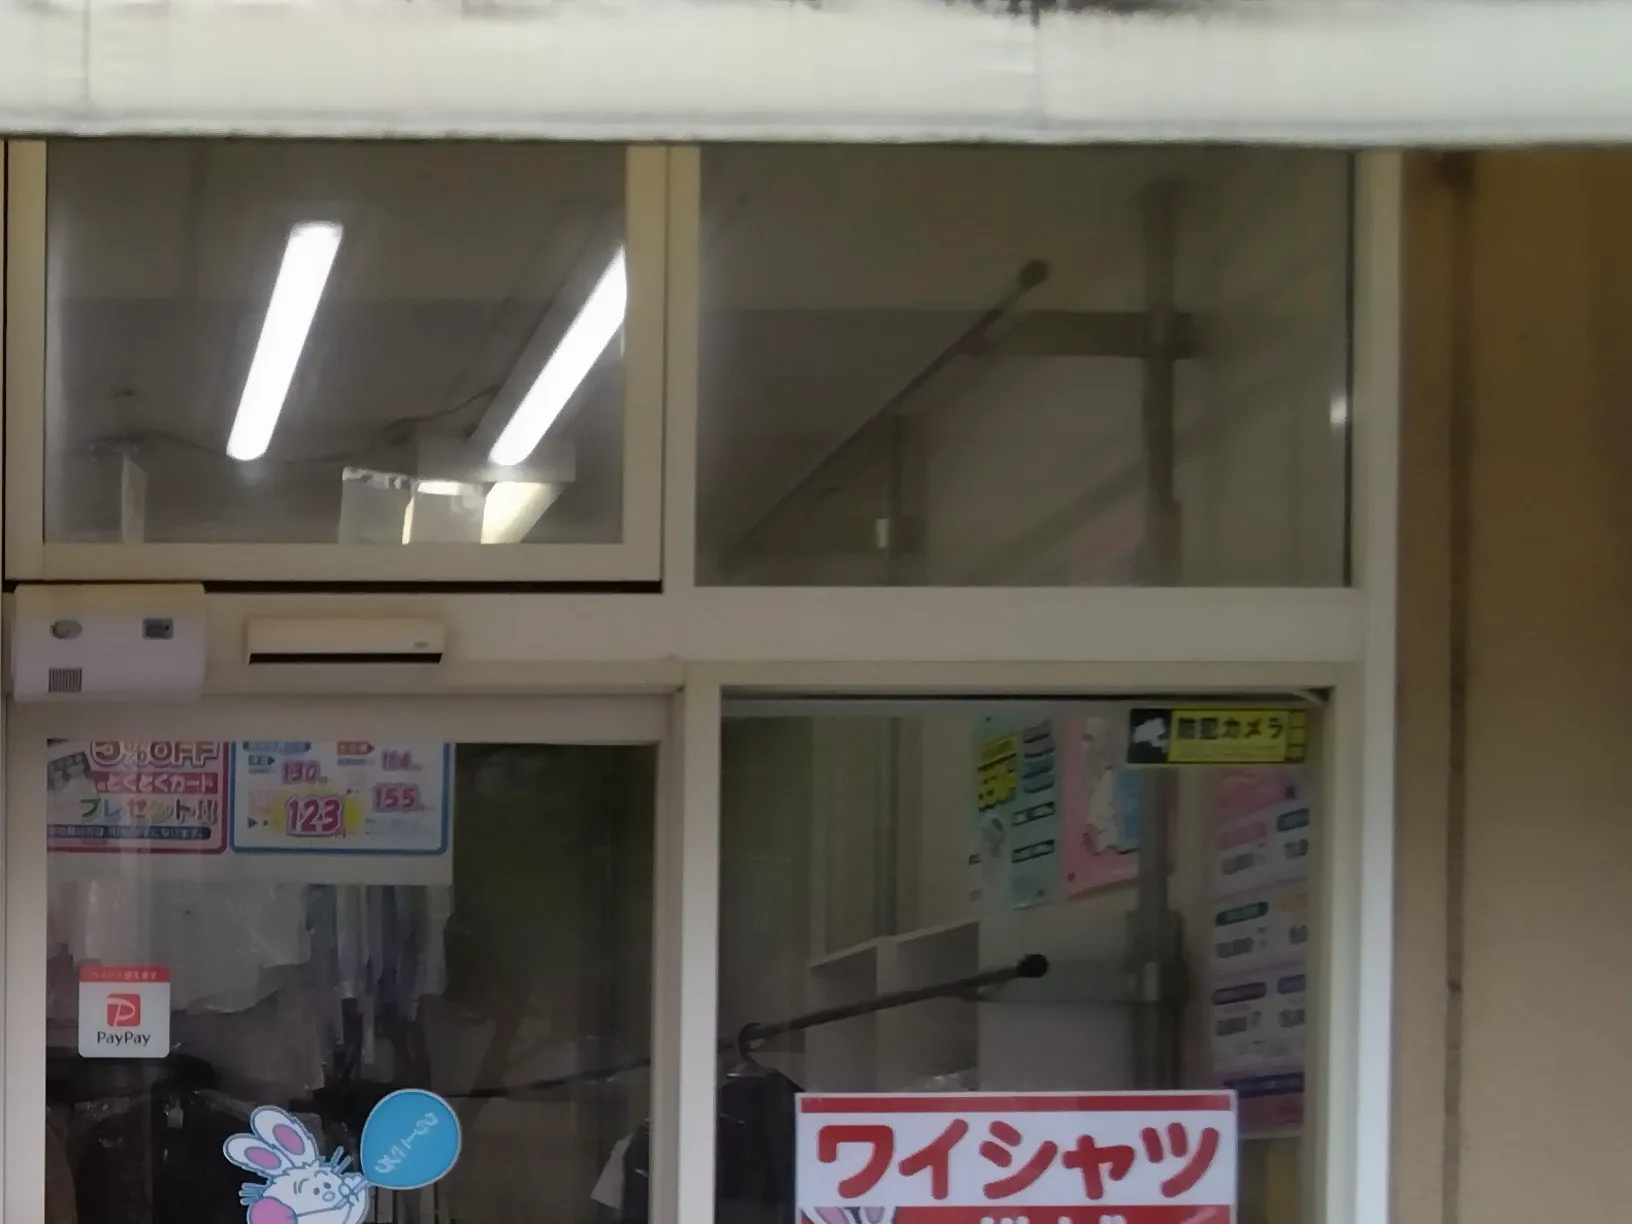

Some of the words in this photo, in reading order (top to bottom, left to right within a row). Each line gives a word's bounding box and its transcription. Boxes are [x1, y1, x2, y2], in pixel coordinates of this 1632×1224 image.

[97, 1031, 151, 1047] PayPay
[818, 1118, 1219, 1200] ワイシャツ
